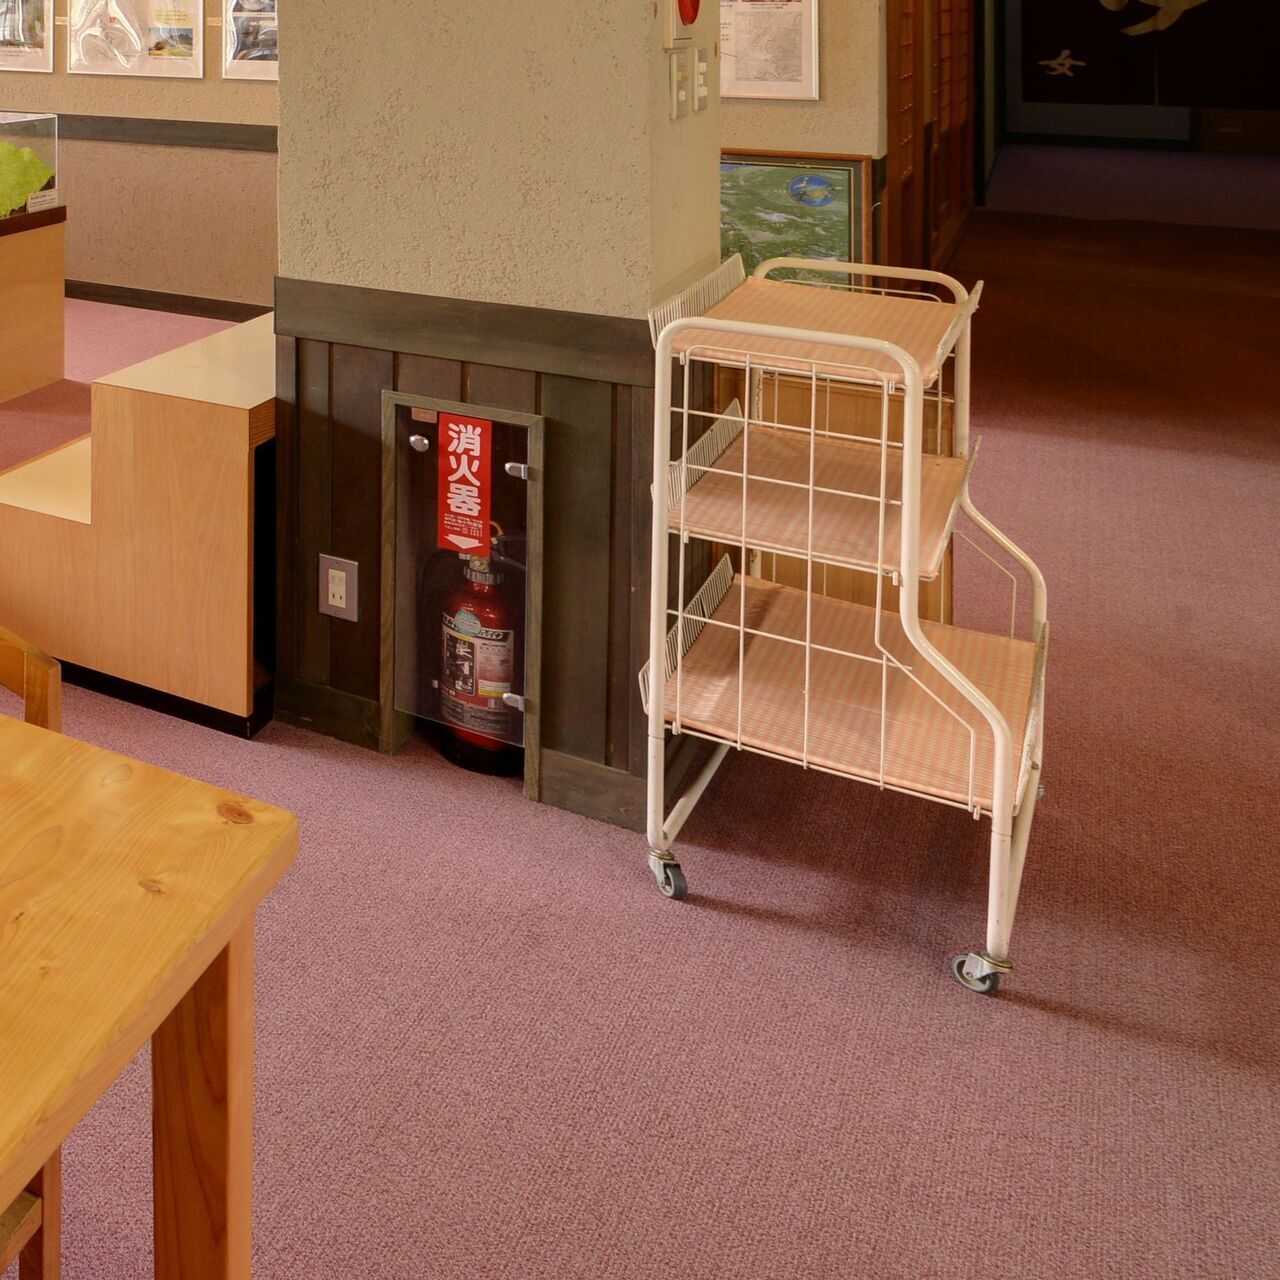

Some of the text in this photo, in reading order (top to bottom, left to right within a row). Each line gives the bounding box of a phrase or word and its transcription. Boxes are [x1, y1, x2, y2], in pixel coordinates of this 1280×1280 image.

[1037, 49, 1087, 77] 女
[446, 422, 482, 517] 消火器
